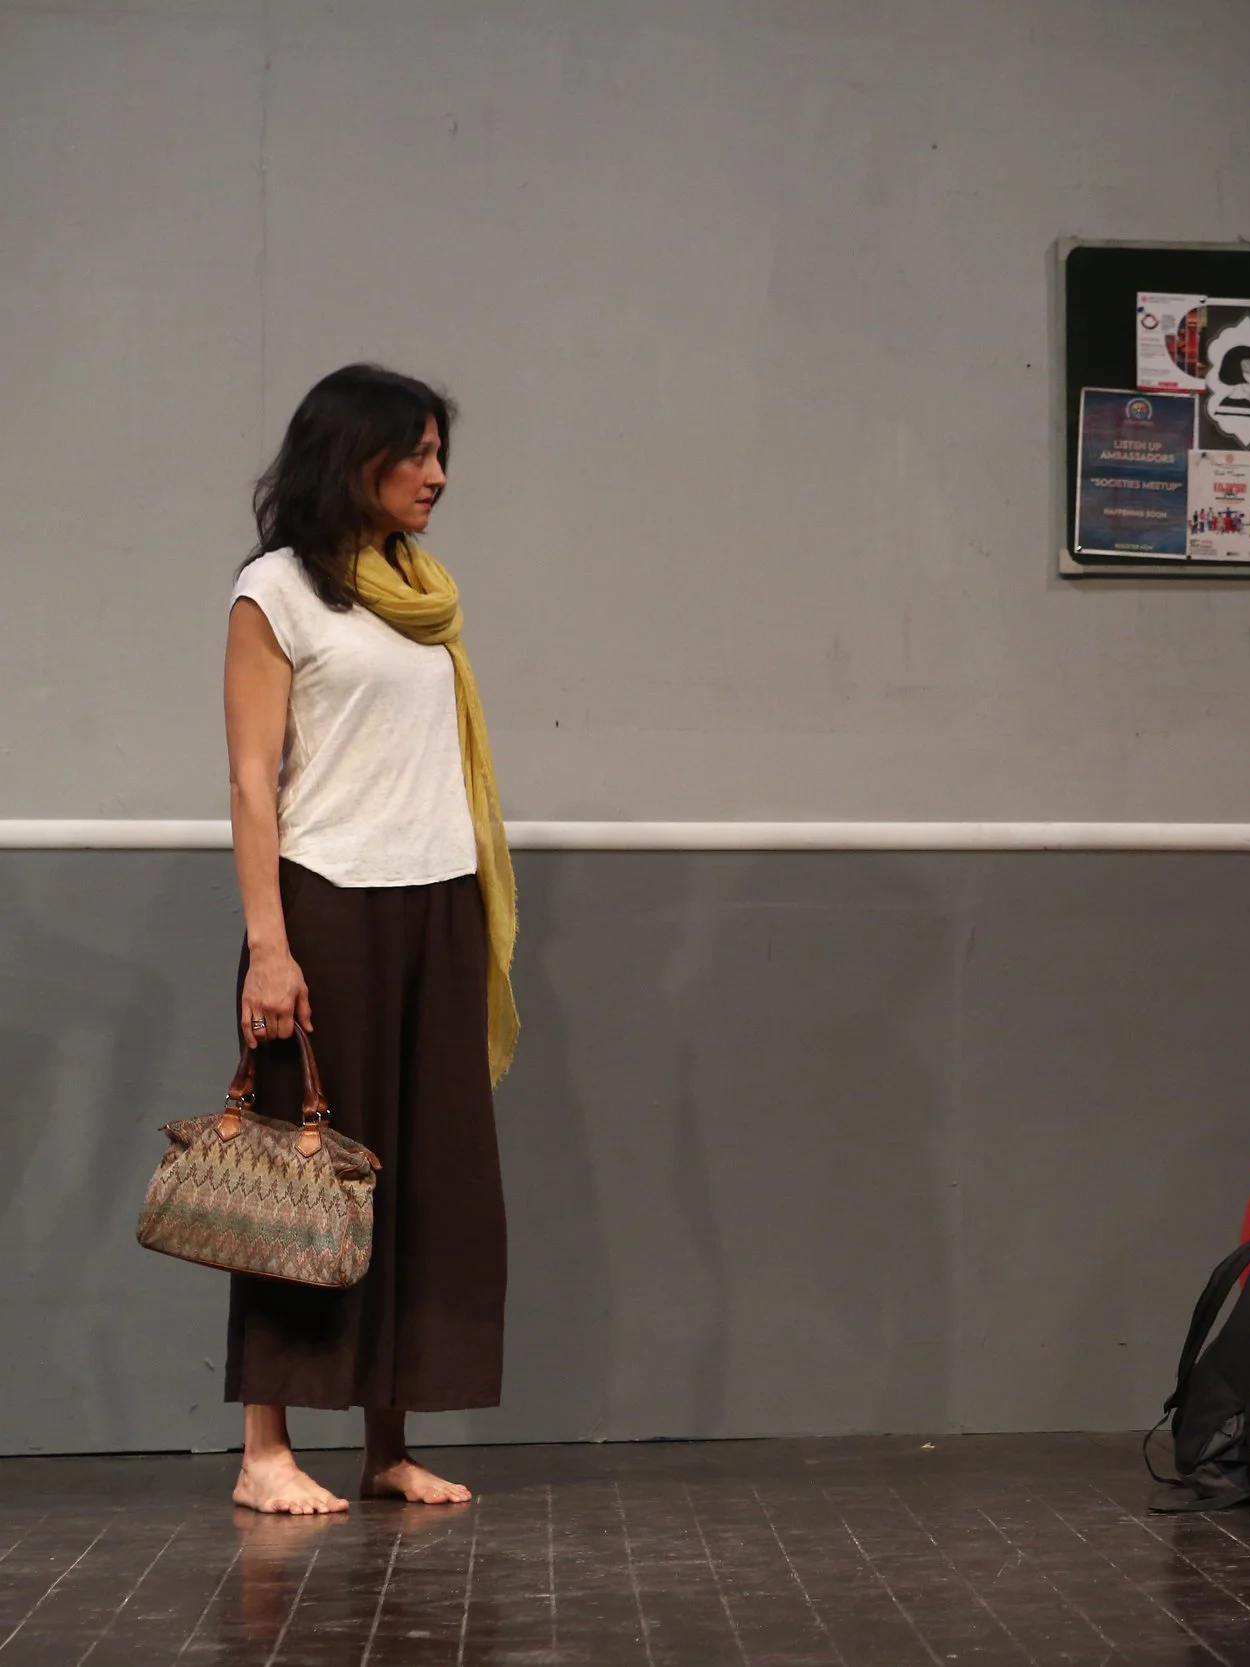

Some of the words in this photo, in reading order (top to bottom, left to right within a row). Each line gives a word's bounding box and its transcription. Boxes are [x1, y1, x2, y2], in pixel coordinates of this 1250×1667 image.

[1114, 440, 1145, 449] LISTEN
[1148, 441, 1161, 450] UP
[1100, 452, 1174, 463] AMBASSADORS
[1104, 508, 1144, 518] HAPPENING
[1146, 510, 1167, 518] SOON
